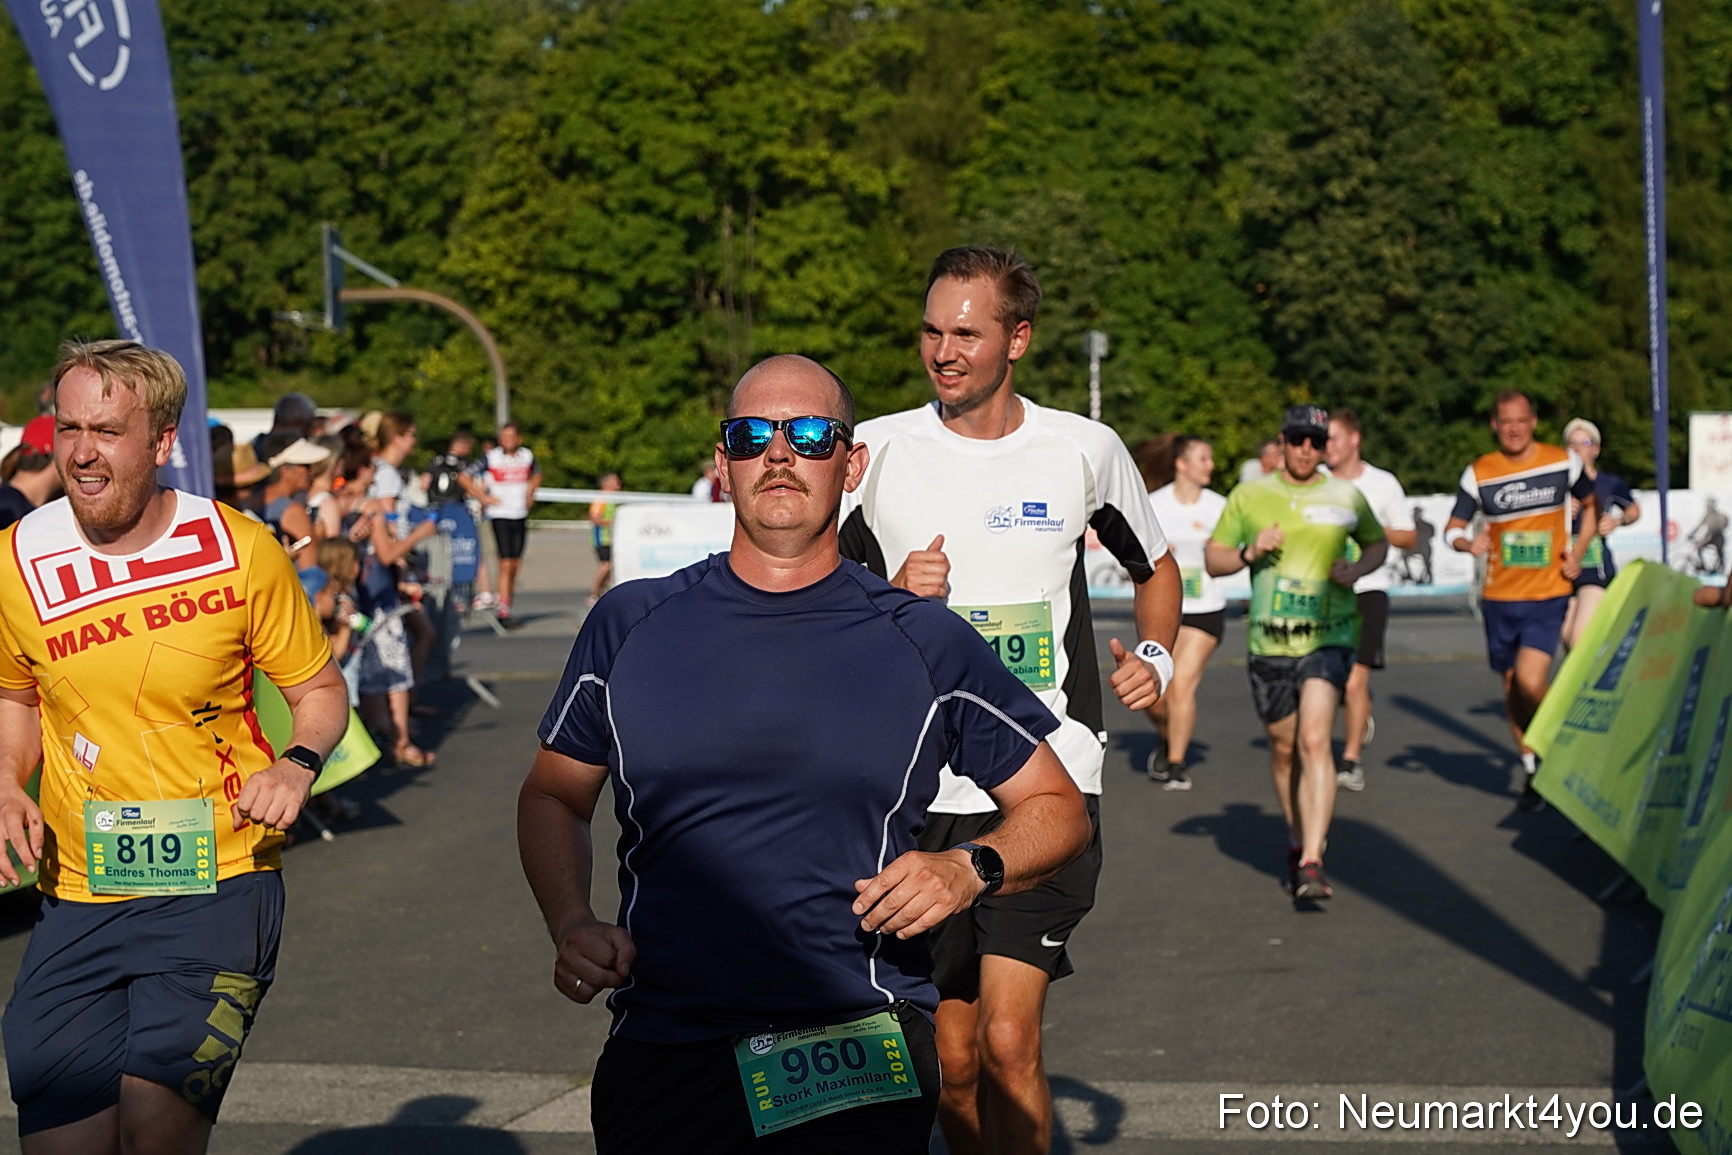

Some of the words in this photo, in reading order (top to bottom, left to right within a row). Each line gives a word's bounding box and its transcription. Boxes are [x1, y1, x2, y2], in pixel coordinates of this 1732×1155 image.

[1014, 517, 1065, 527] Firmenlauf
[45, 612, 134, 662] MAX
[142, 586, 247, 631] BÖGL
[988, 634, 1026, 664] 19
[1038, 636, 1051, 678] 2022
[116, 817, 156, 827] Firmenlauf
[92, 843, 106, 876] RUN
[117, 833, 182, 865] 819
[196, 836, 210, 880] 2022
[105, 866, 145, 878] Endres
[149, 867, 197, 878] Thomas
[797, 1030, 828, 1042] neumarkt
[781, 1037, 867, 1085] 960
[882, 1038, 909, 1085] 2022
[752, 1071, 774, 1112] RUN
[773, 1085, 814, 1108] Stork
[815, 1071, 892, 1095] Maximilan
